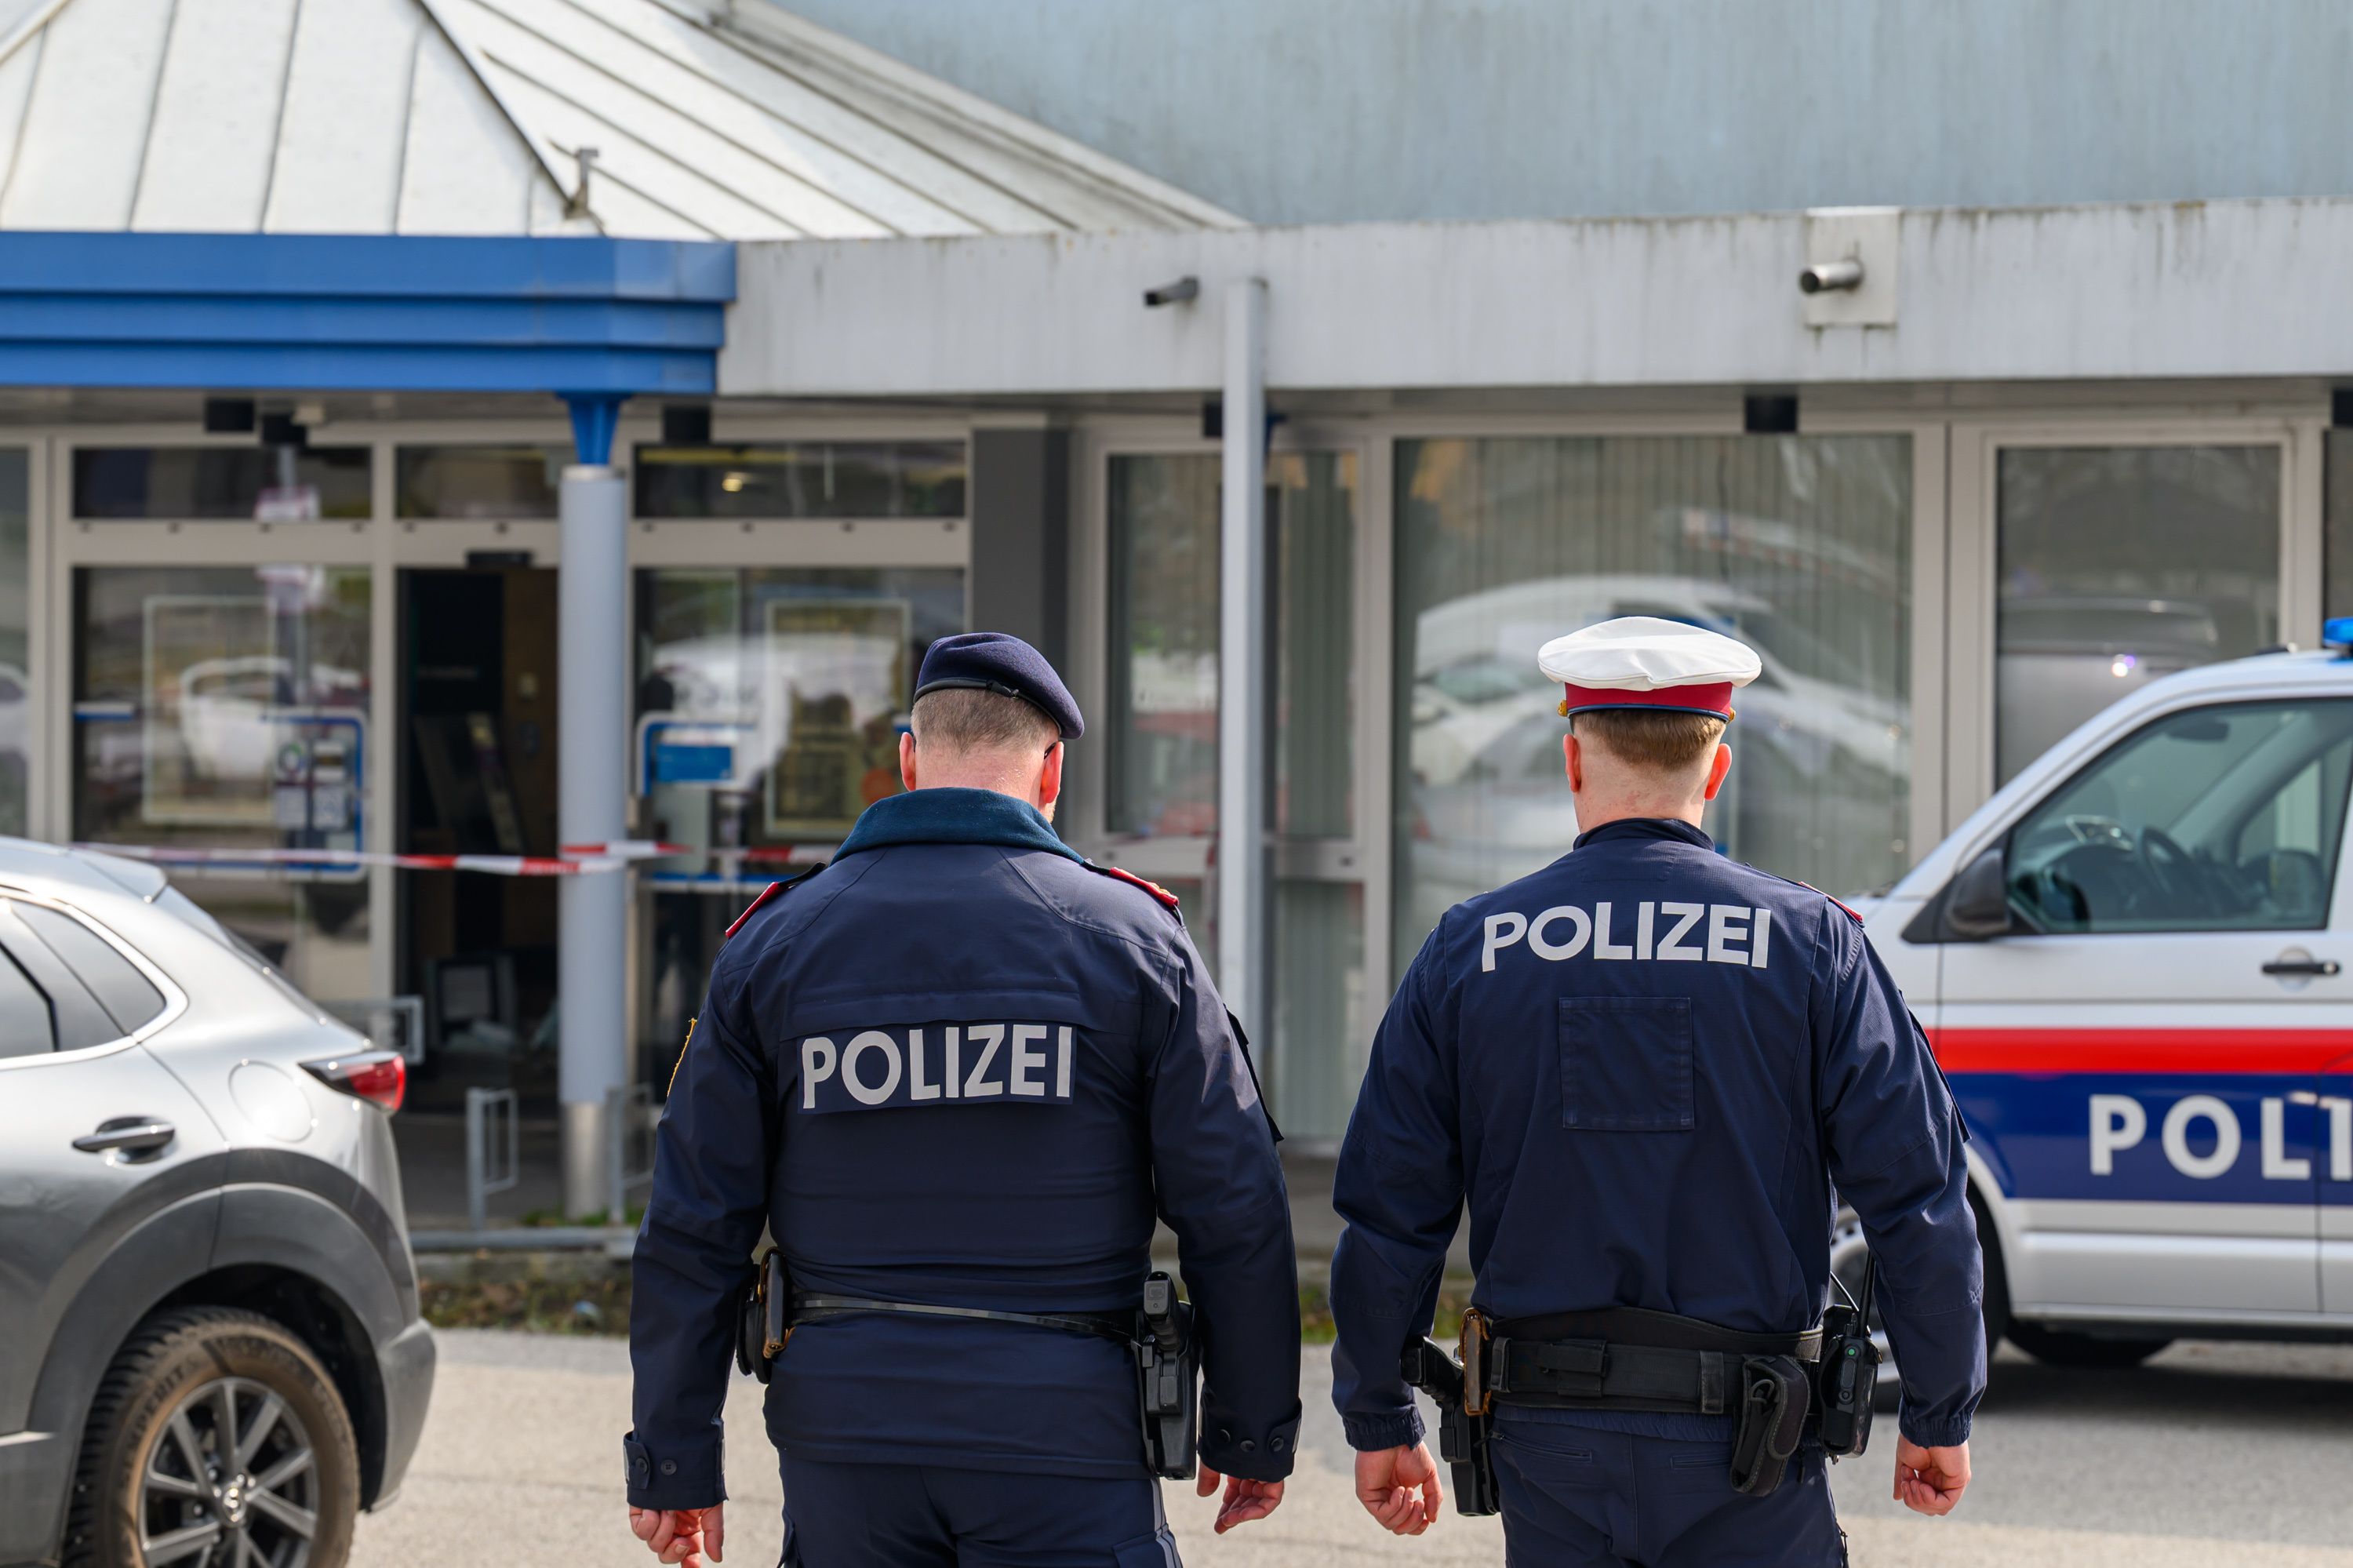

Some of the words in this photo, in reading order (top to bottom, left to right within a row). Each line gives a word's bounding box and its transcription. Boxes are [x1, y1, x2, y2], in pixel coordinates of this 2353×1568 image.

[1481, 900, 1772, 973] POLIZEI
[801, 1023, 1073, 1110] POLIZEI
[2089, 1094, 2353, 1181] POLI
